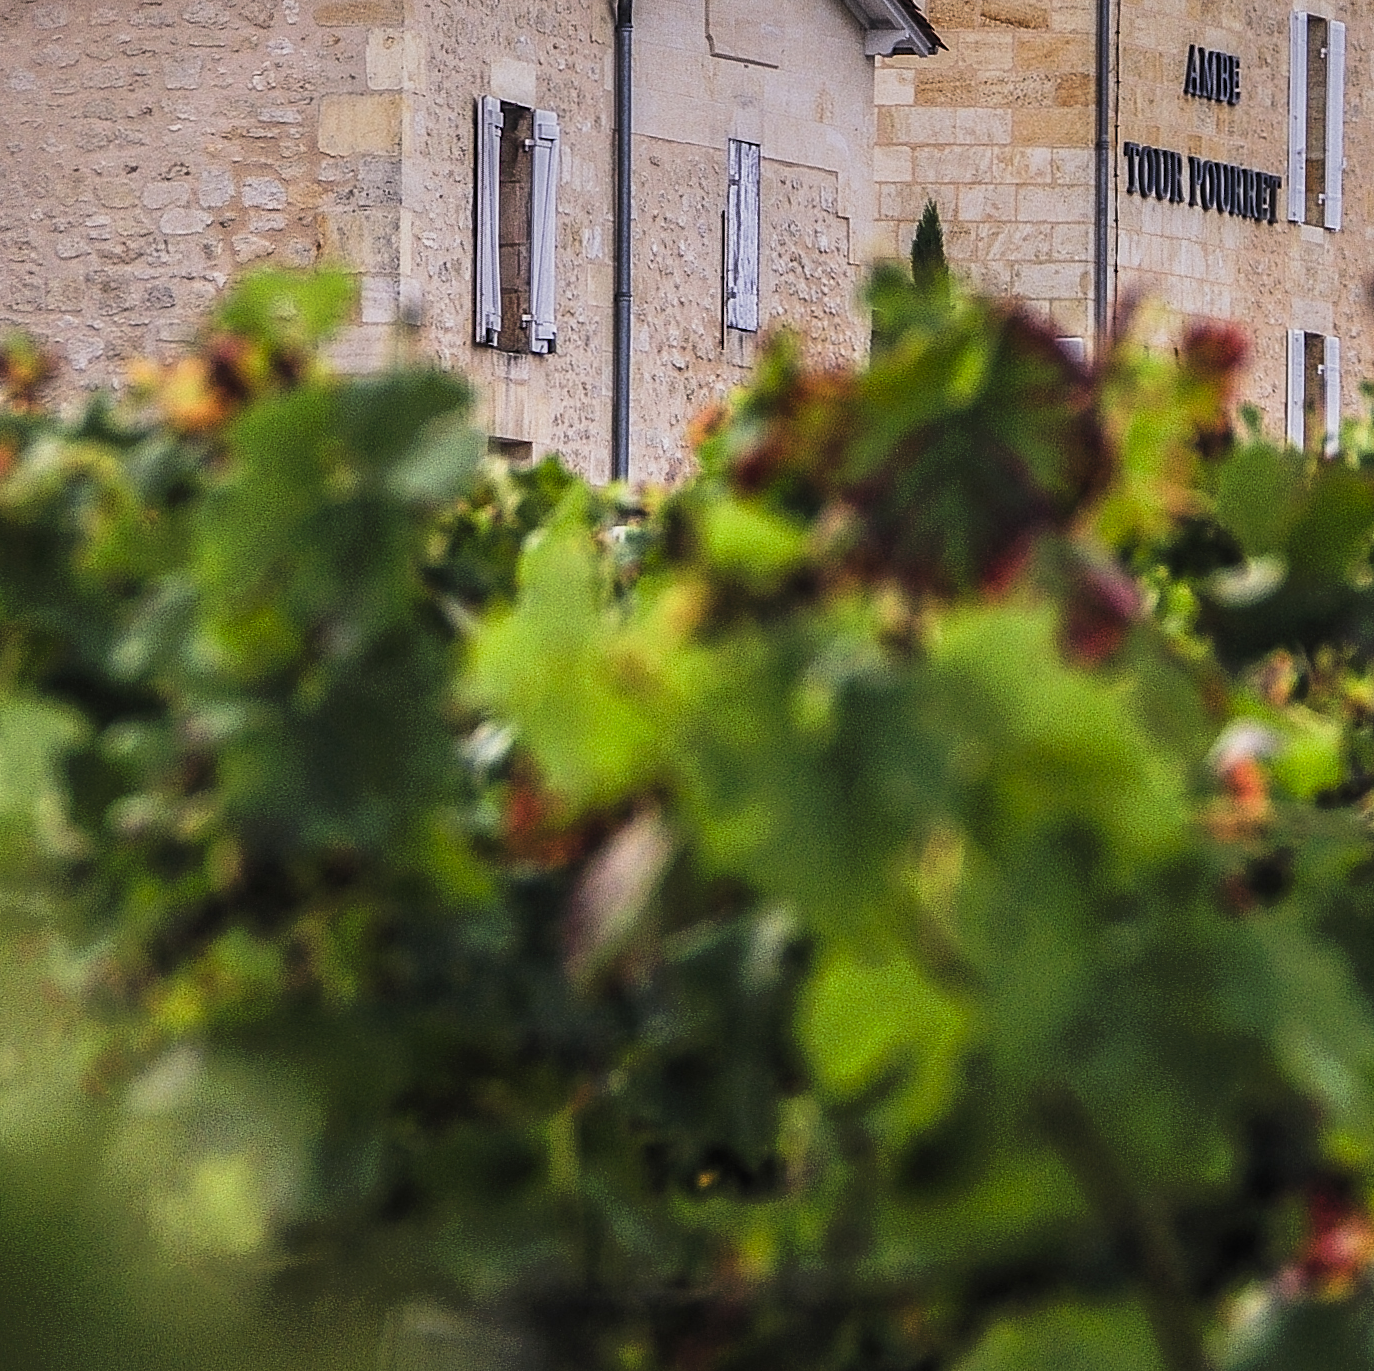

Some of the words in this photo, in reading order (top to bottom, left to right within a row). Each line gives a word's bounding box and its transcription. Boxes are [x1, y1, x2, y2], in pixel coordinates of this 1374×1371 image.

[1183, 44, 1241, 106] AMBE
[1123, 141, 1185, 204] TOUR
[1188, 156, 1282, 224] POURRET
